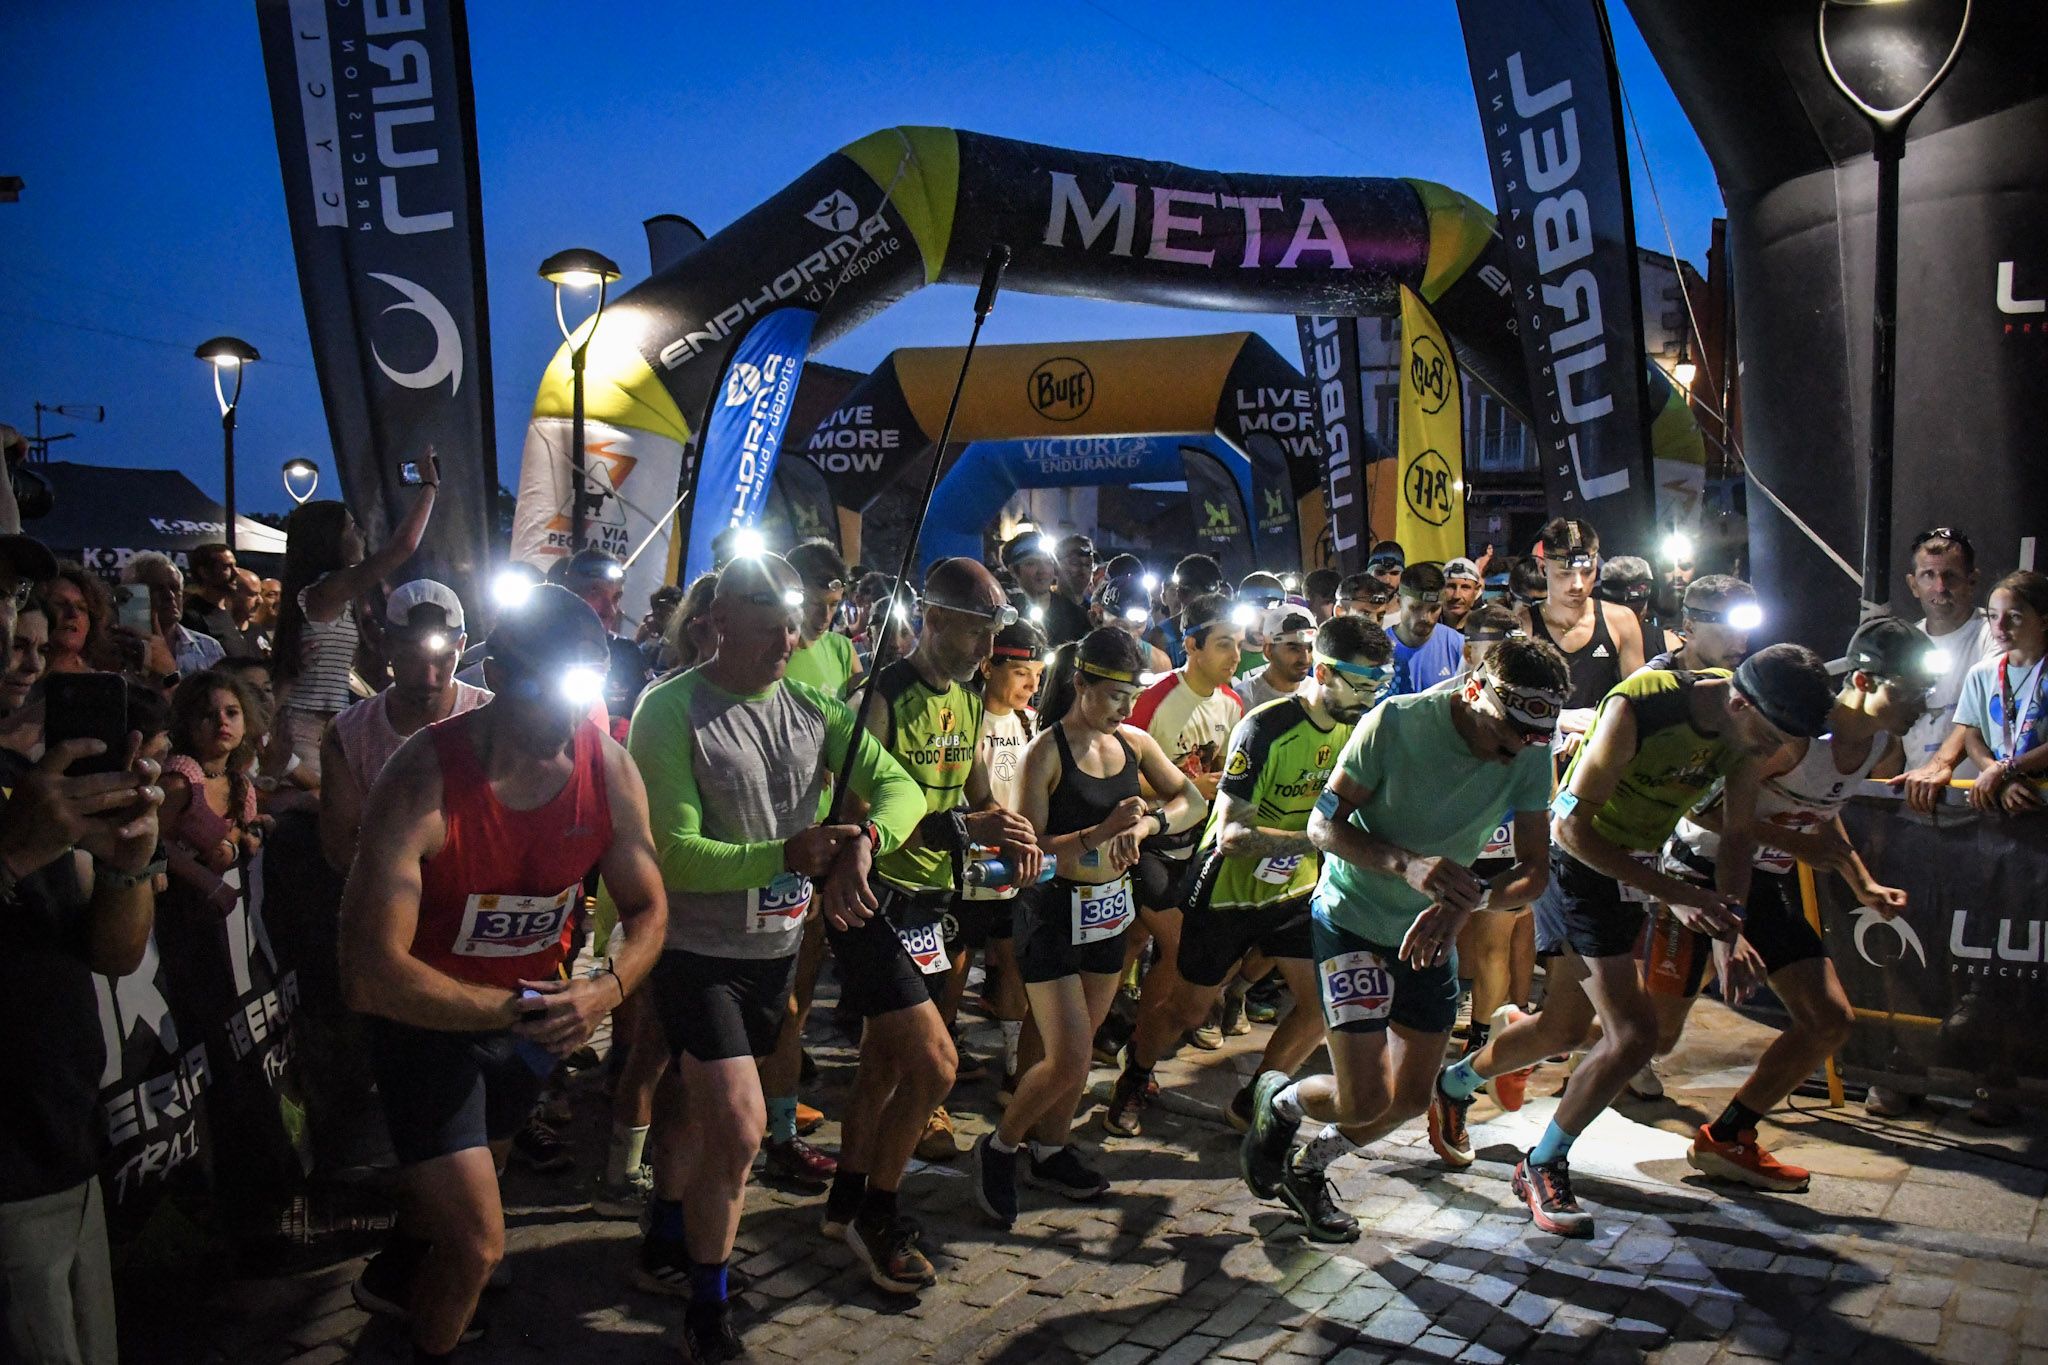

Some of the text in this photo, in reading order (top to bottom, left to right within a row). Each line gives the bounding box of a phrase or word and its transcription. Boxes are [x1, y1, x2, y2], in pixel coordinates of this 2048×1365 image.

[1042, 171, 1353, 269] META
[841, 236, 900, 284] deporte
[660, 214, 891, 371] ENPHORMA
[770, 357, 796, 427] deporte
[1237, 387, 1313, 411] LIVE
[817, 405, 874, 430] LIVE
[1239, 412, 1317, 436] MOR
[809, 429, 900, 451] MORE
[602, 526, 629, 543] VIA
[1084, 892, 1125, 923] 389
[482, 911, 557, 938] 319
[1332, 968, 1382, 998] 361
